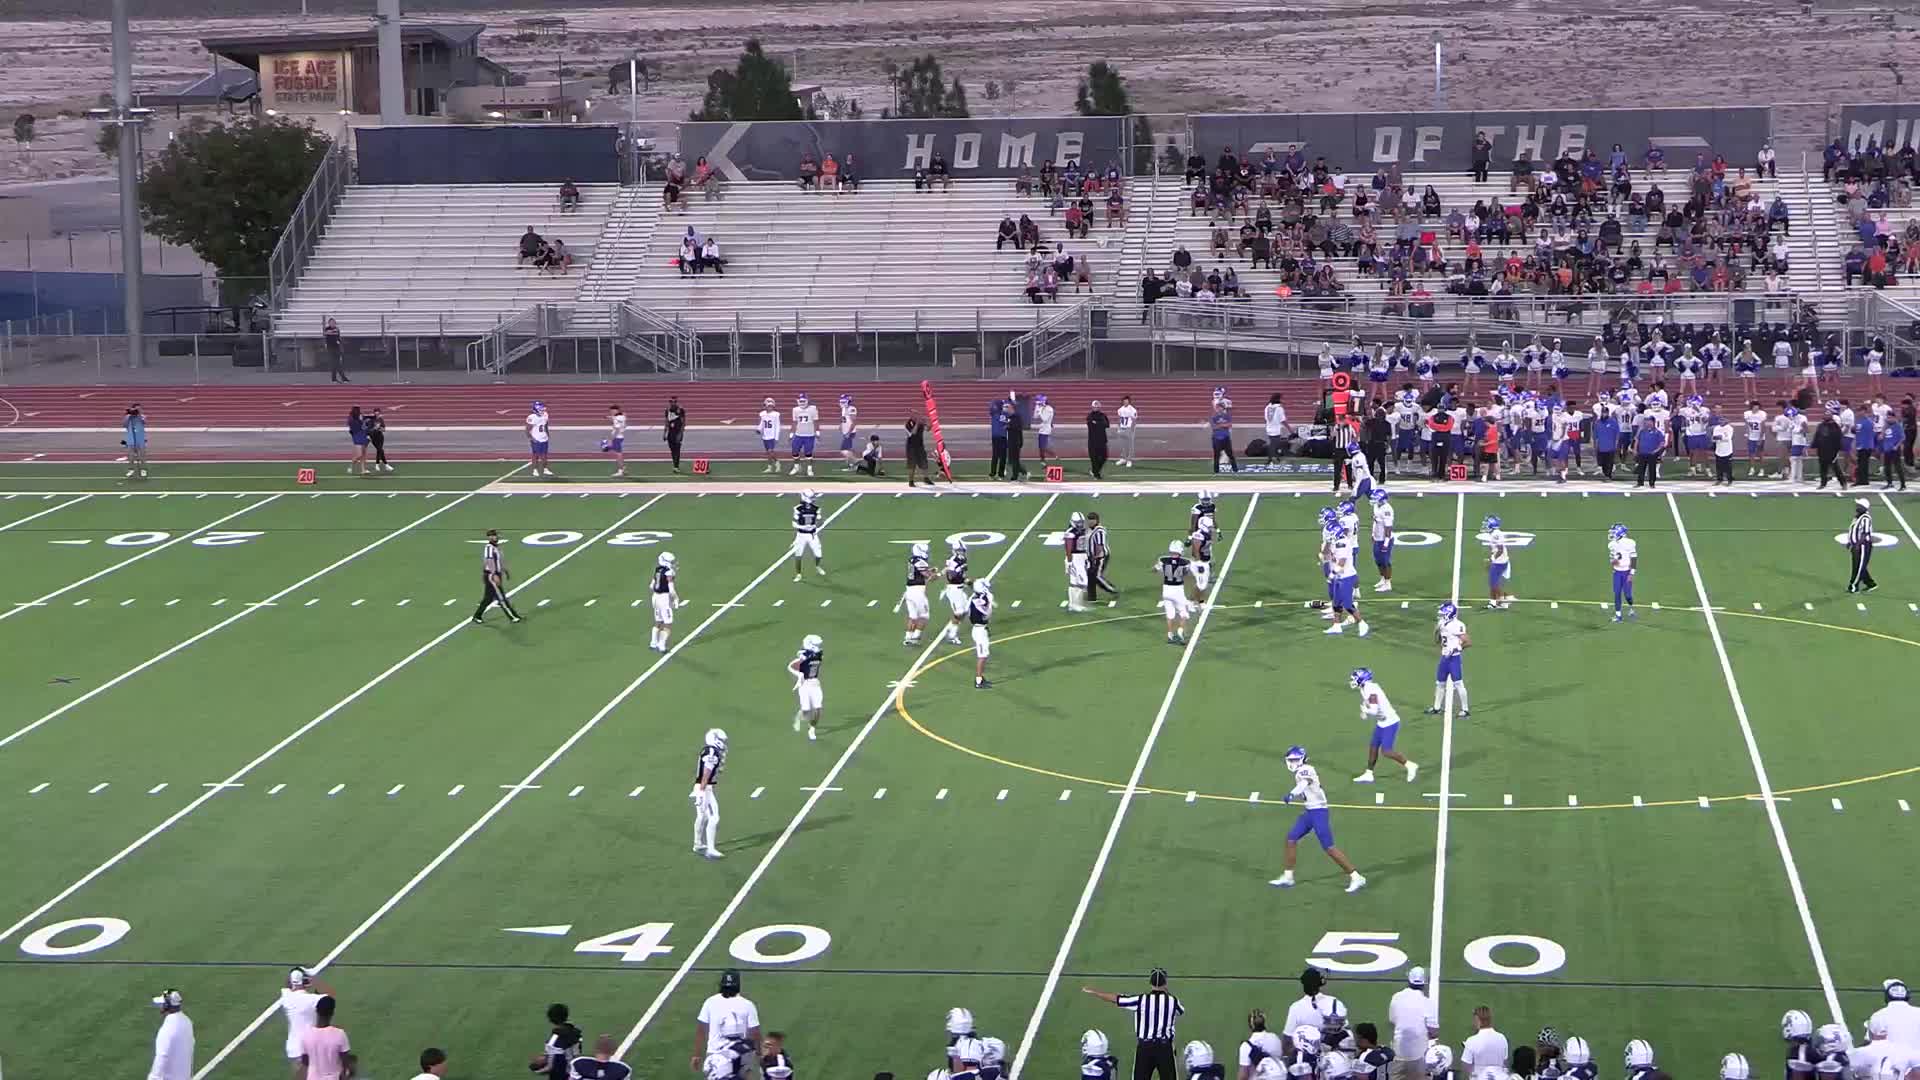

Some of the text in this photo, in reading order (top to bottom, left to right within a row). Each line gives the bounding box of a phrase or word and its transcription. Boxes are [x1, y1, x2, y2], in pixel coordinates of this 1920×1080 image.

[274, 59, 337, 75] ICE AGE
[903, 131, 1085, 169] HOME
[1371, 126, 1445, 163] OF
[1474, 124, 1589, 162] THE
[694, 459, 706, 473] 30
[1451, 466, 1466, 479] 50
[298, 470, 313, 482] 20
[1047, 468, 1061, 481] 40
